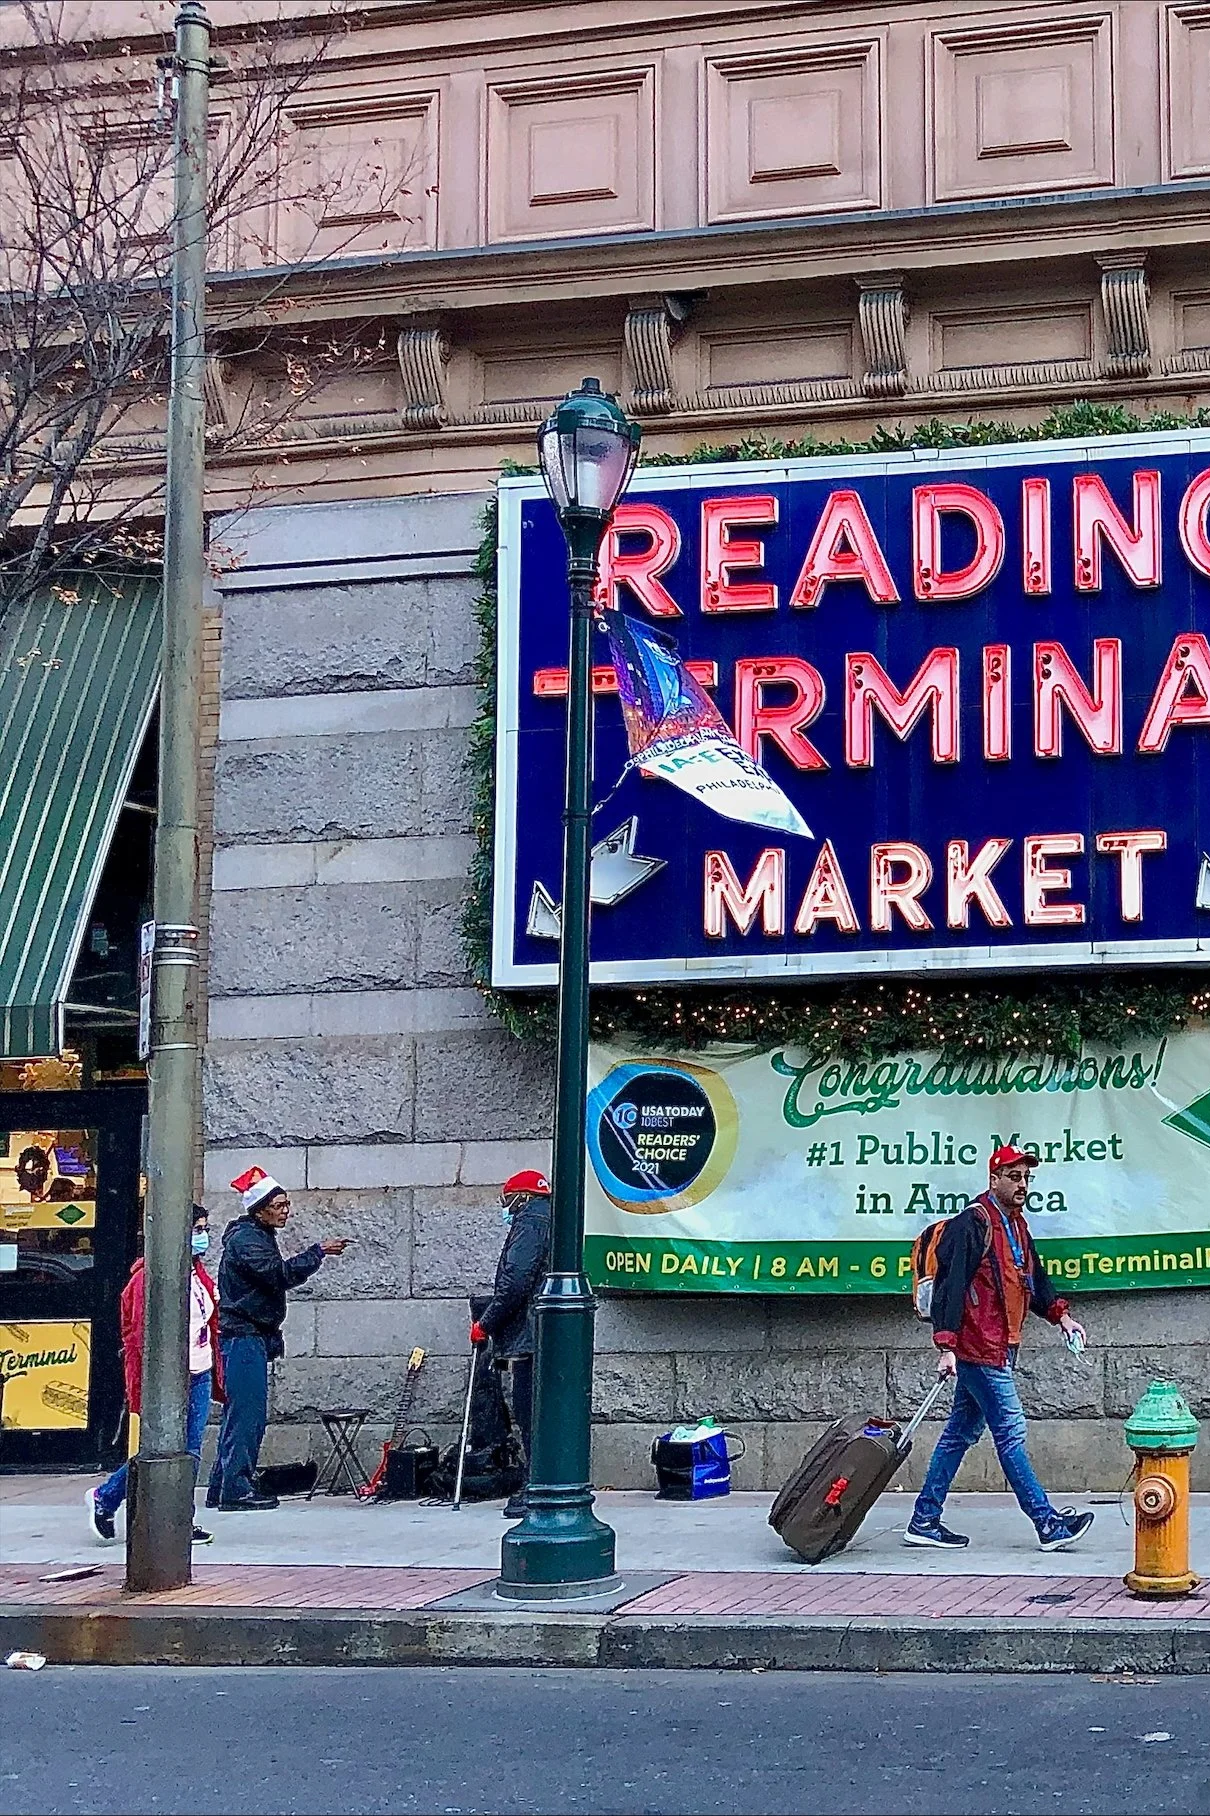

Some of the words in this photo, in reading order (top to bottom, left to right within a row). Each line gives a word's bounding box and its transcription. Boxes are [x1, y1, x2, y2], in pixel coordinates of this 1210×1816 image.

[703, 829, 1167, 939] MARKET
[641, 1116, 675, 1127] 10BEST
[637, 1133, 700, 1147] READERS'
[806, 1141, 845, 1168] #1
[855, 1131, 978, 1166] Public
[635, 1148, 687, 1161] CHOICE
[632, 1160, 659, 1175] 2021
[855, 1184, 894, 1215] in
[904, 1183, 1068, 1215] Amca
[606, 1250, 652, 1275] OPEN
[661, 1253, 744, 1280] DAILY
[770, 1257, 787, 1278] 8
[795, 1256, 839, 1278] AM
[870, 1257, 888, 1278] 6
[898, 1256, 913, 1278] P
